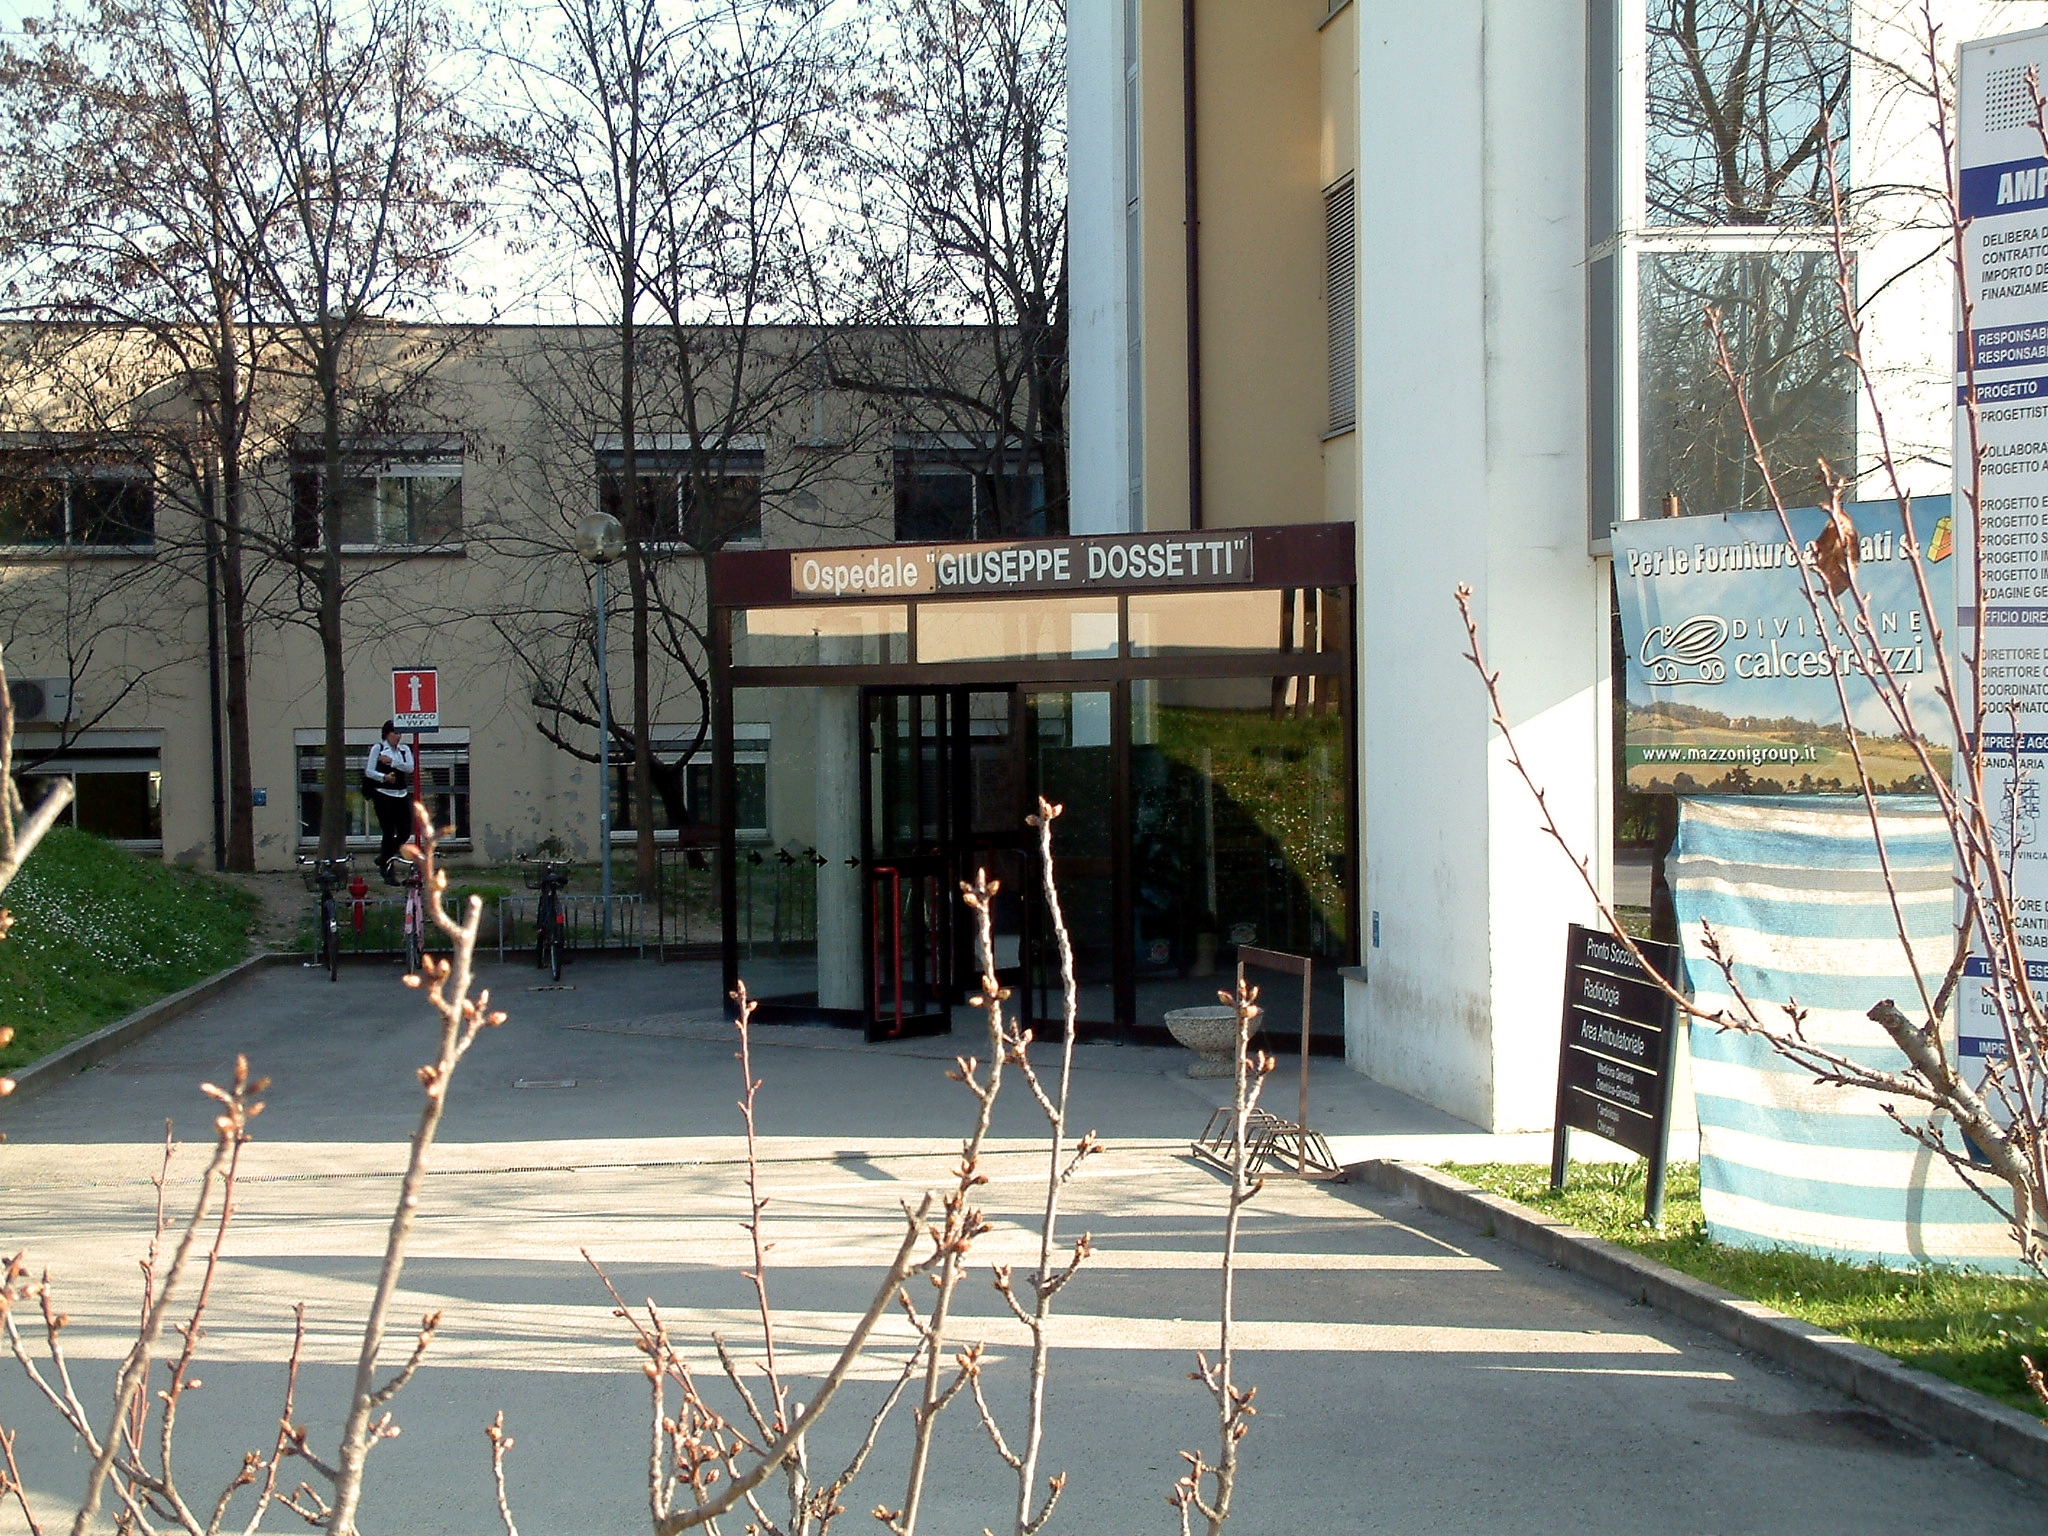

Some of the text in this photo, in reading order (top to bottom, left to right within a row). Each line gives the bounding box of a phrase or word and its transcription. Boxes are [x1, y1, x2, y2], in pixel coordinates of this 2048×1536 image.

[1996, 166, 2048, 206] AMP
[1982, 228, 2039, 247] DELIBERA
[1982, 244, 2048, 265] CONTRATTO
[1981, 265, 2033, 283] IMPORTO
[1981, 280, 2048, 301] FINANZIAME
[1977, 381, 2038, 399] PROGETTO
[1981, 405, 2048, 422] PROGETTIST
[1981, 442, 2048, 458] OLLABORA
[1980, 460, 2039, 475] PROGETTO
[1980, 496, 2039, 511] PROGETTO
[1980, 514, 2039, 528] PROGETTO
[1980, 532, 2038, 546] PROGETTO
[1627, 548, 1663, 576] Per
[1668, 545, 1690, 575] le
[1694, 539, 1799, 573] Forniture
[1980, 550, 2038, 564] PROGETTO
[802, 540, 1245, 597] Ospedale "GIUSEPPE DOSSETTI"
[1980, 568, 2038, 582] PROGETTO
[1984, 610, 2019, 623] FFICIO
[1982, 648, 2040, 661] DIRETTORE
[1981, 666, 2040, 678] DIRETTORE
[1981, 684, 2048, 696] COORDINATO
[1981, 701, 2048, 713] COOINATO
[1981, 735, 2025, 749] MPREE
[1643, 744, 1817, 767] www.mazzonigroup.it
[1982, 758, 2045, 769] ANDAARIA
[1999, 850, 2048, 860] PRVINCIA
[1586, 937, 1610, 961] Pronto
[1583, 977, 1620, 1008] Radiologia
[1581, 1019, 1645, 1057] Area Ambulatoriale
